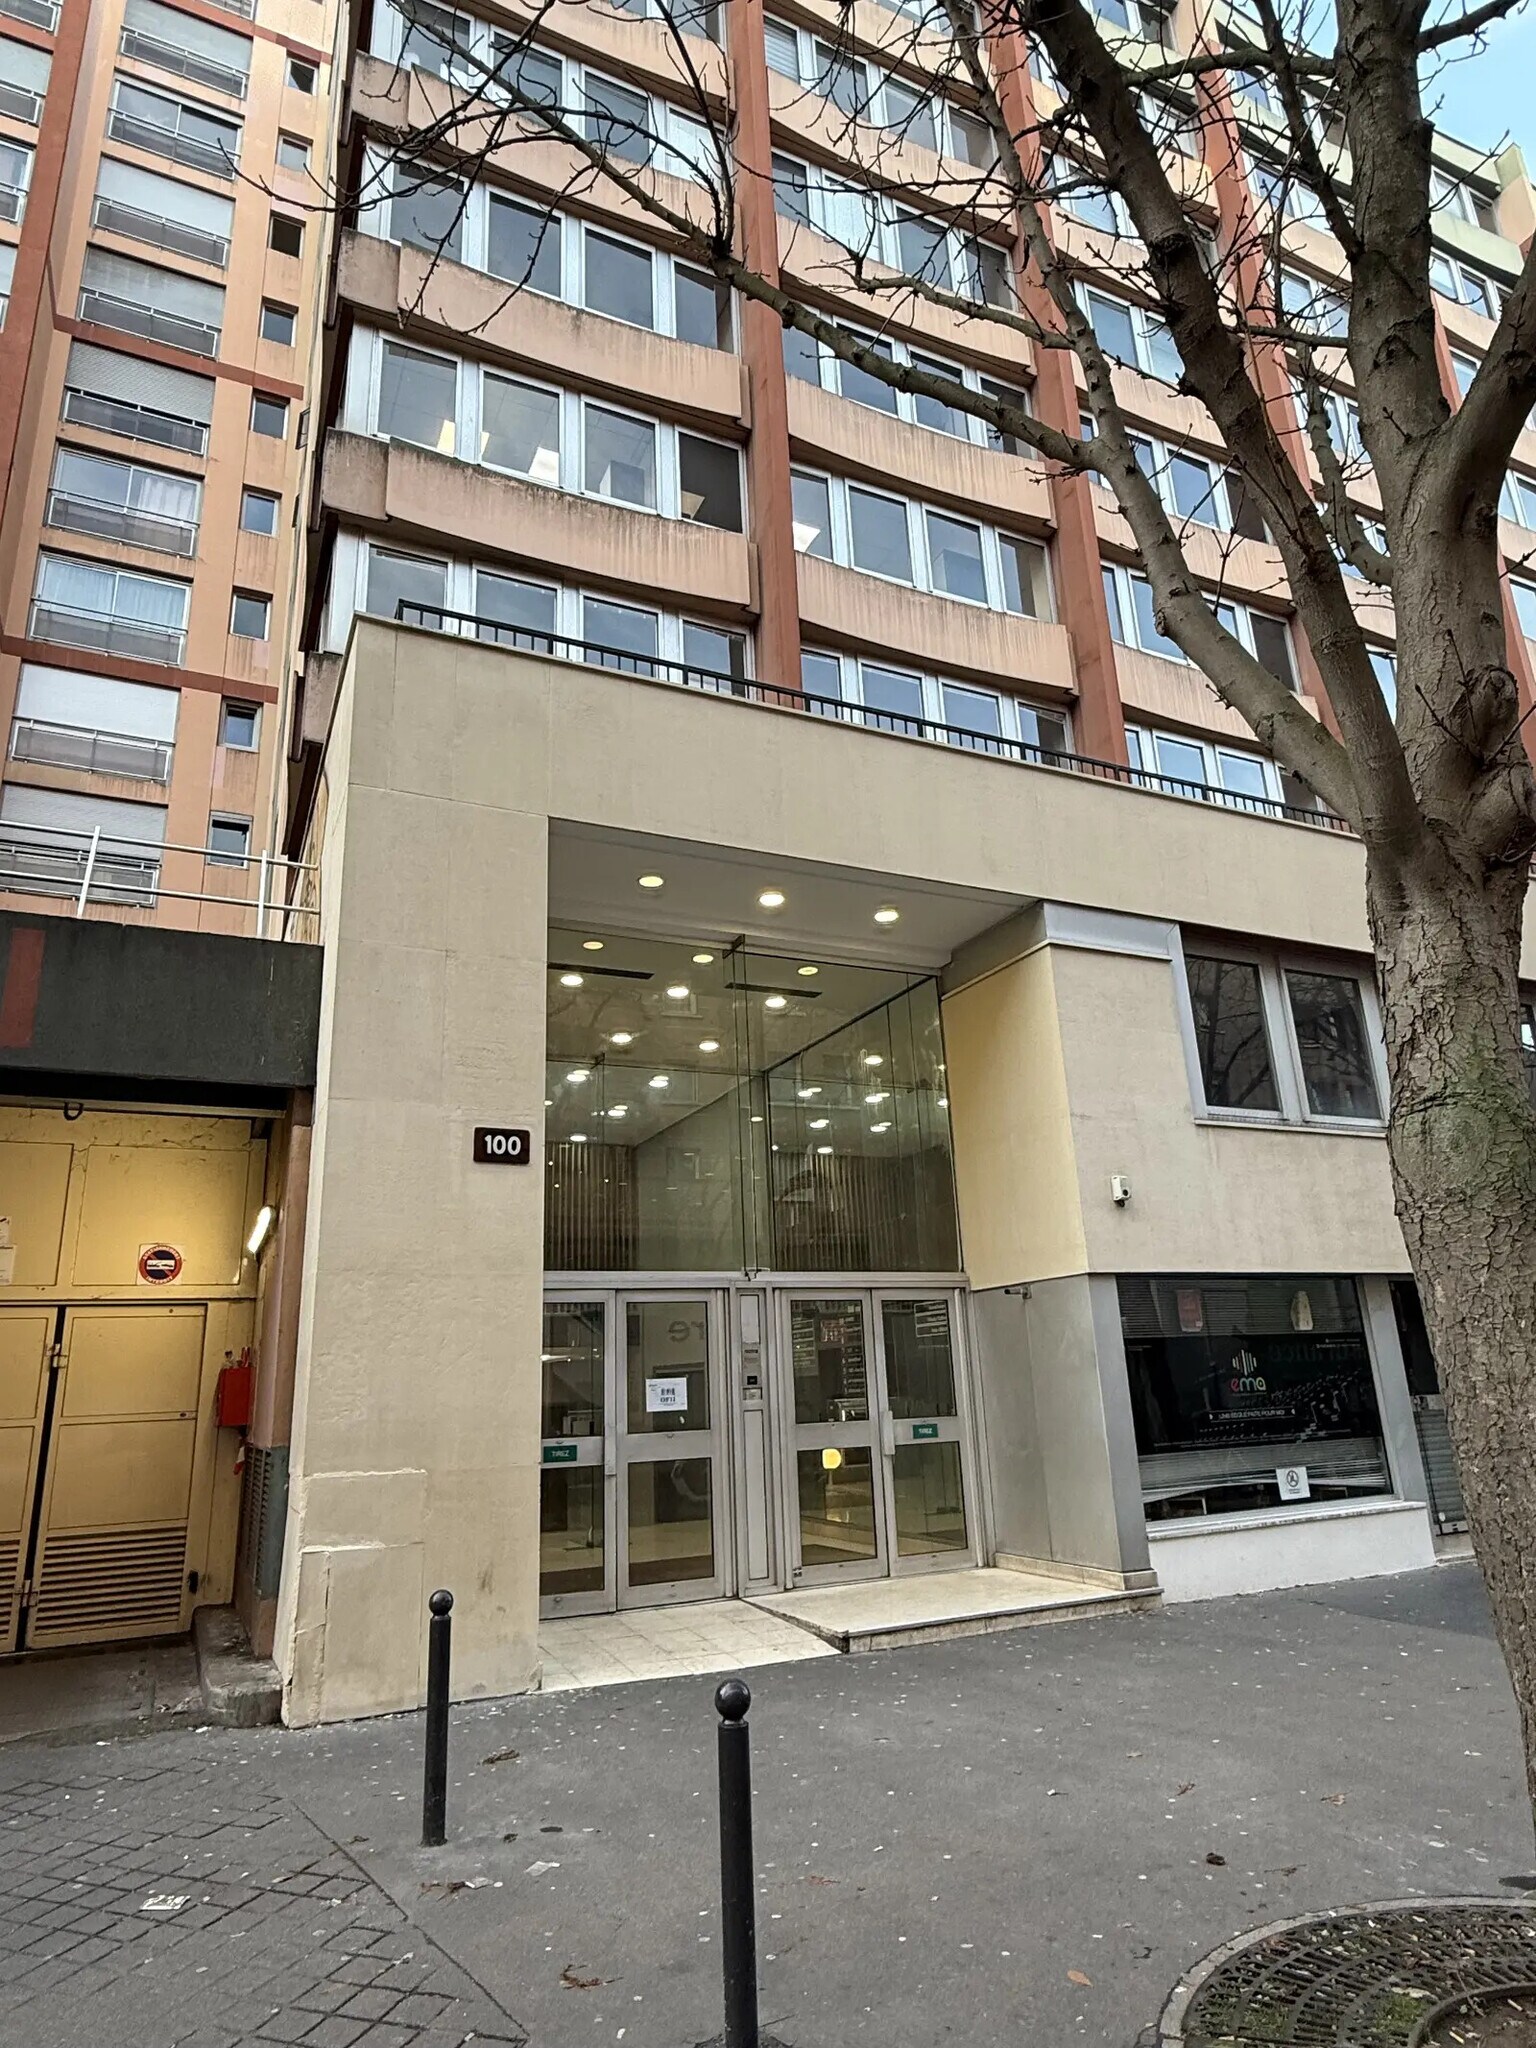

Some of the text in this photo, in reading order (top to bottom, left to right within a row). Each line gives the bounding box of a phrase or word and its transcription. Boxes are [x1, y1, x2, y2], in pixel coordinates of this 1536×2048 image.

[484, 1135, 522, 1155] 100
[1230, 1377, 1267, 1392] ema
[551, 1449, 570, 1457] TIREZ
